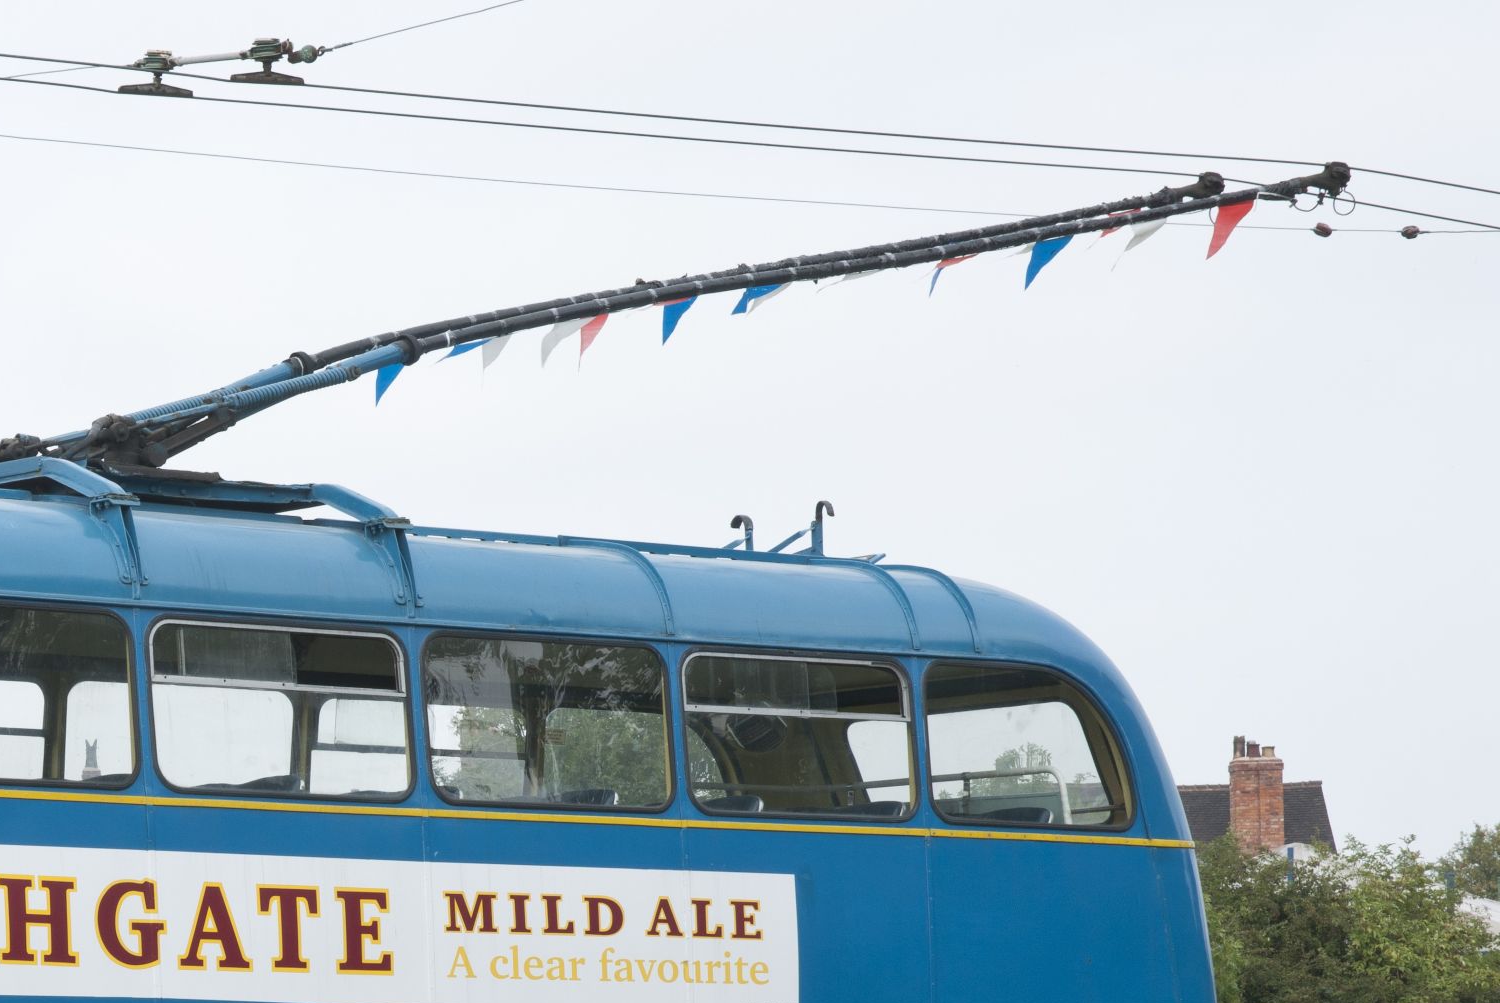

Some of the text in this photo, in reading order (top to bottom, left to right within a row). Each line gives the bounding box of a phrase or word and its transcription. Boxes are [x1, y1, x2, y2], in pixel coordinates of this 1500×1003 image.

[443, 891, 764, 941] MILD ALE
[447, 944, 770, 985] A clear favourite
